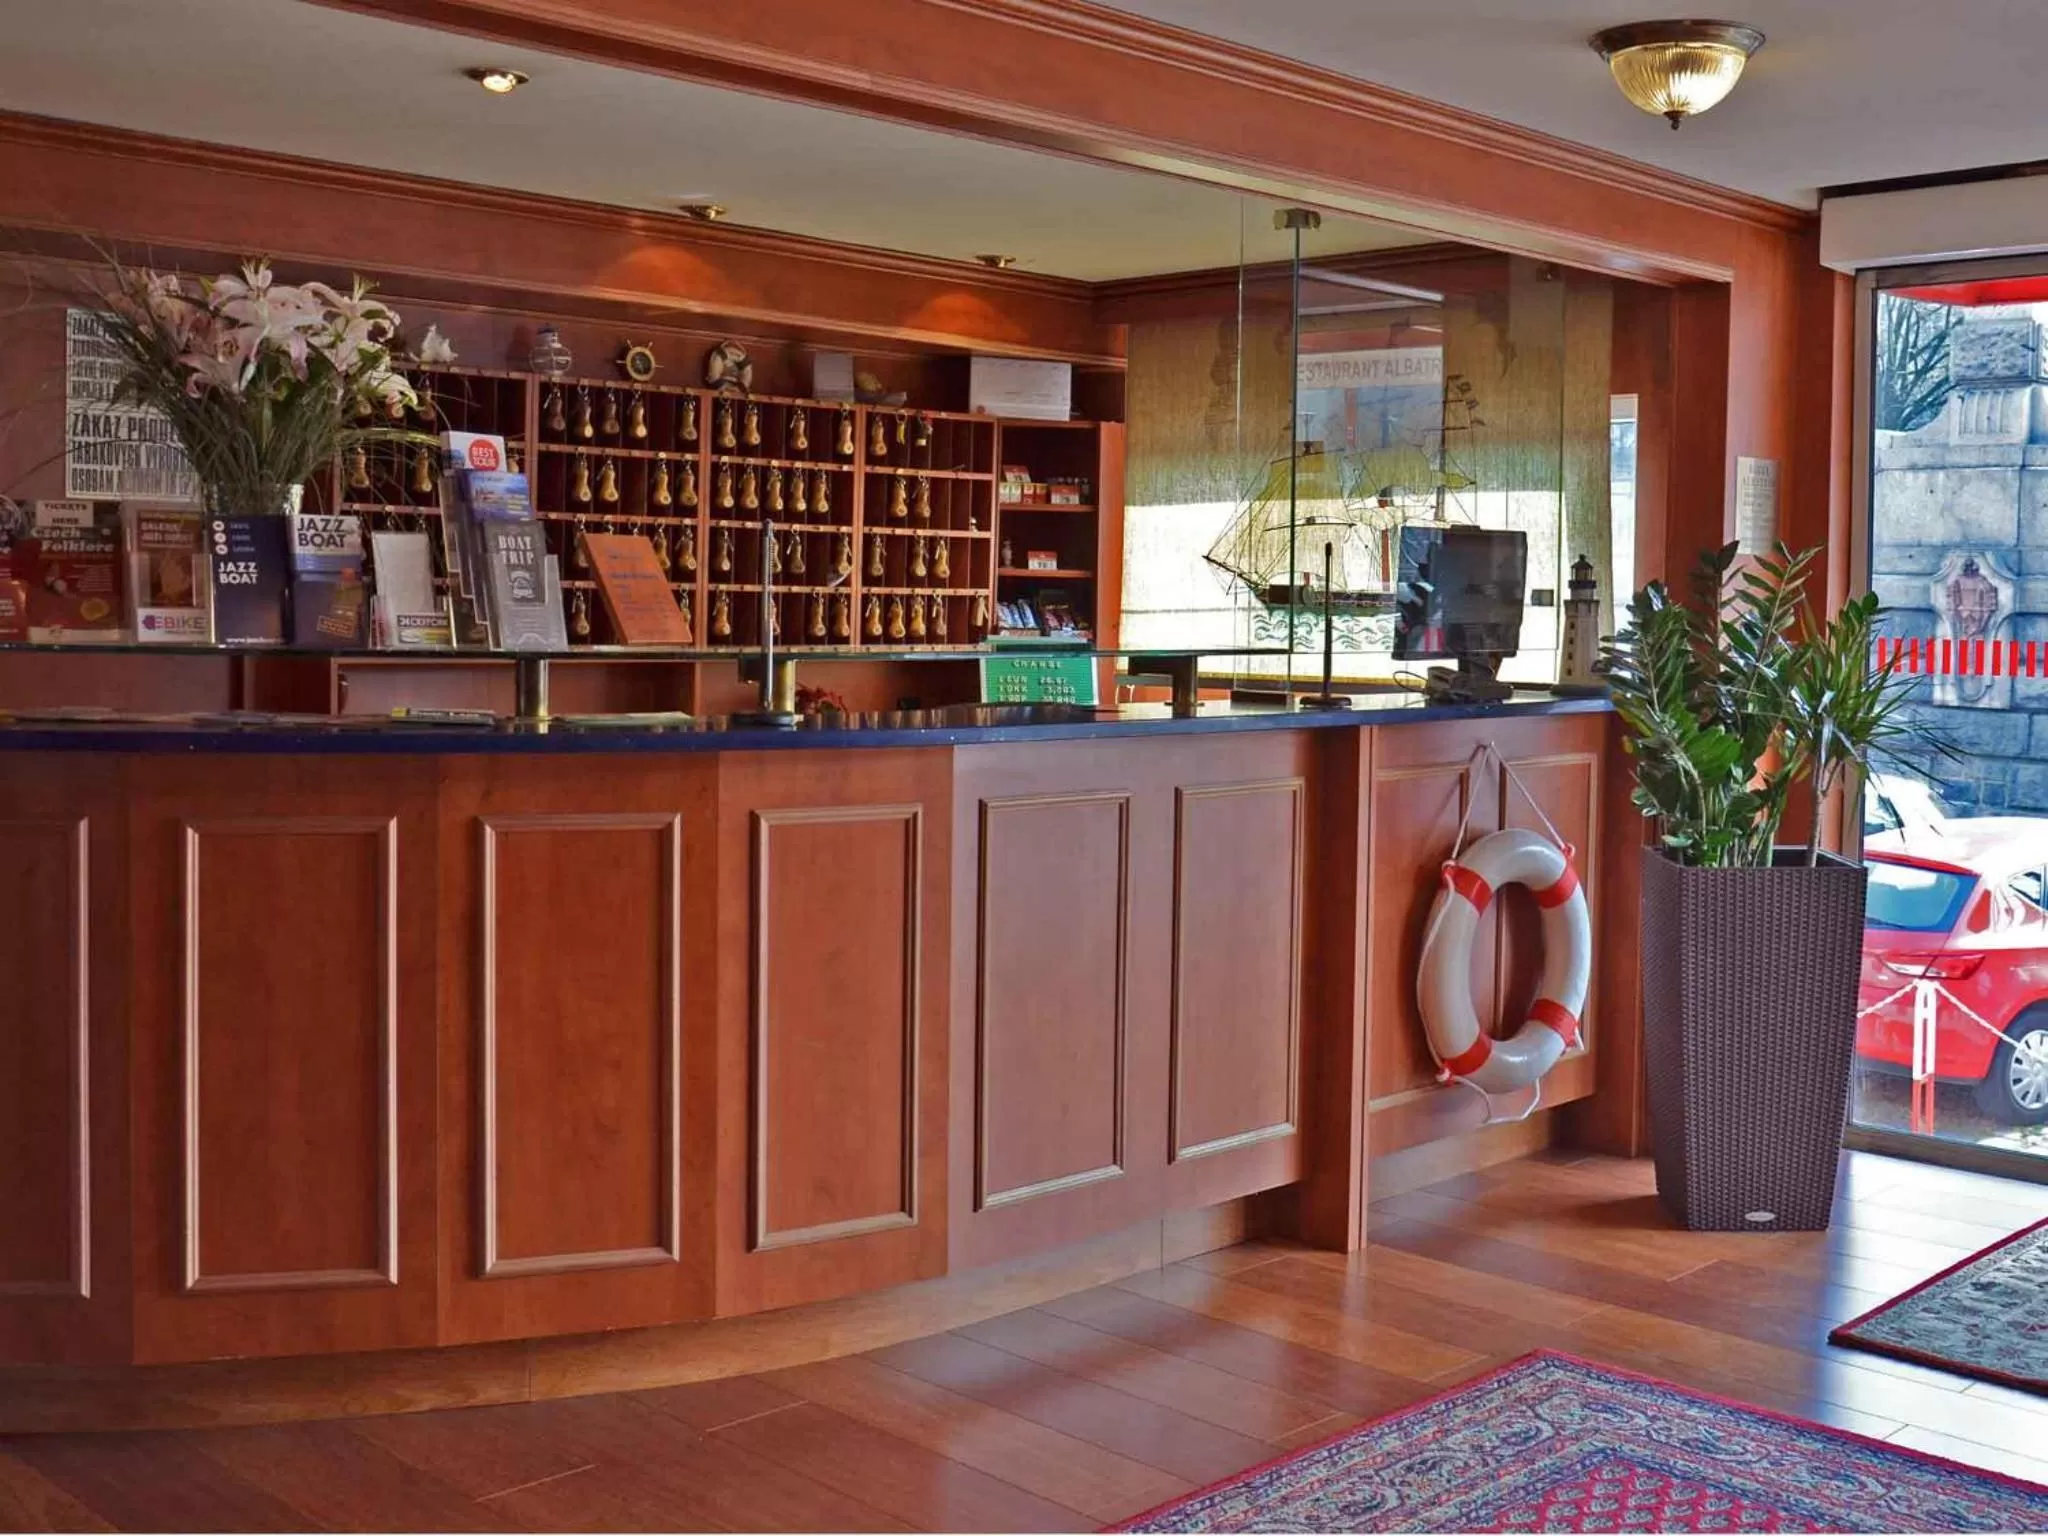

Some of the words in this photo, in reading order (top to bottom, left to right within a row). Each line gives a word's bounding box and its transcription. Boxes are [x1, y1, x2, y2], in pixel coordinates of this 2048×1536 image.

[297, 518, 345, 533] JAZZ
[40, 539, 116, 553] Folklore
[299, 533, 347, 549] BOAT
[497, 534, 533, 550] BOAT
[500, 549, 535, 565] TRIP
[218, 561, 259, 573] JAZZ
[219, 573, 259, 585] BOAT
